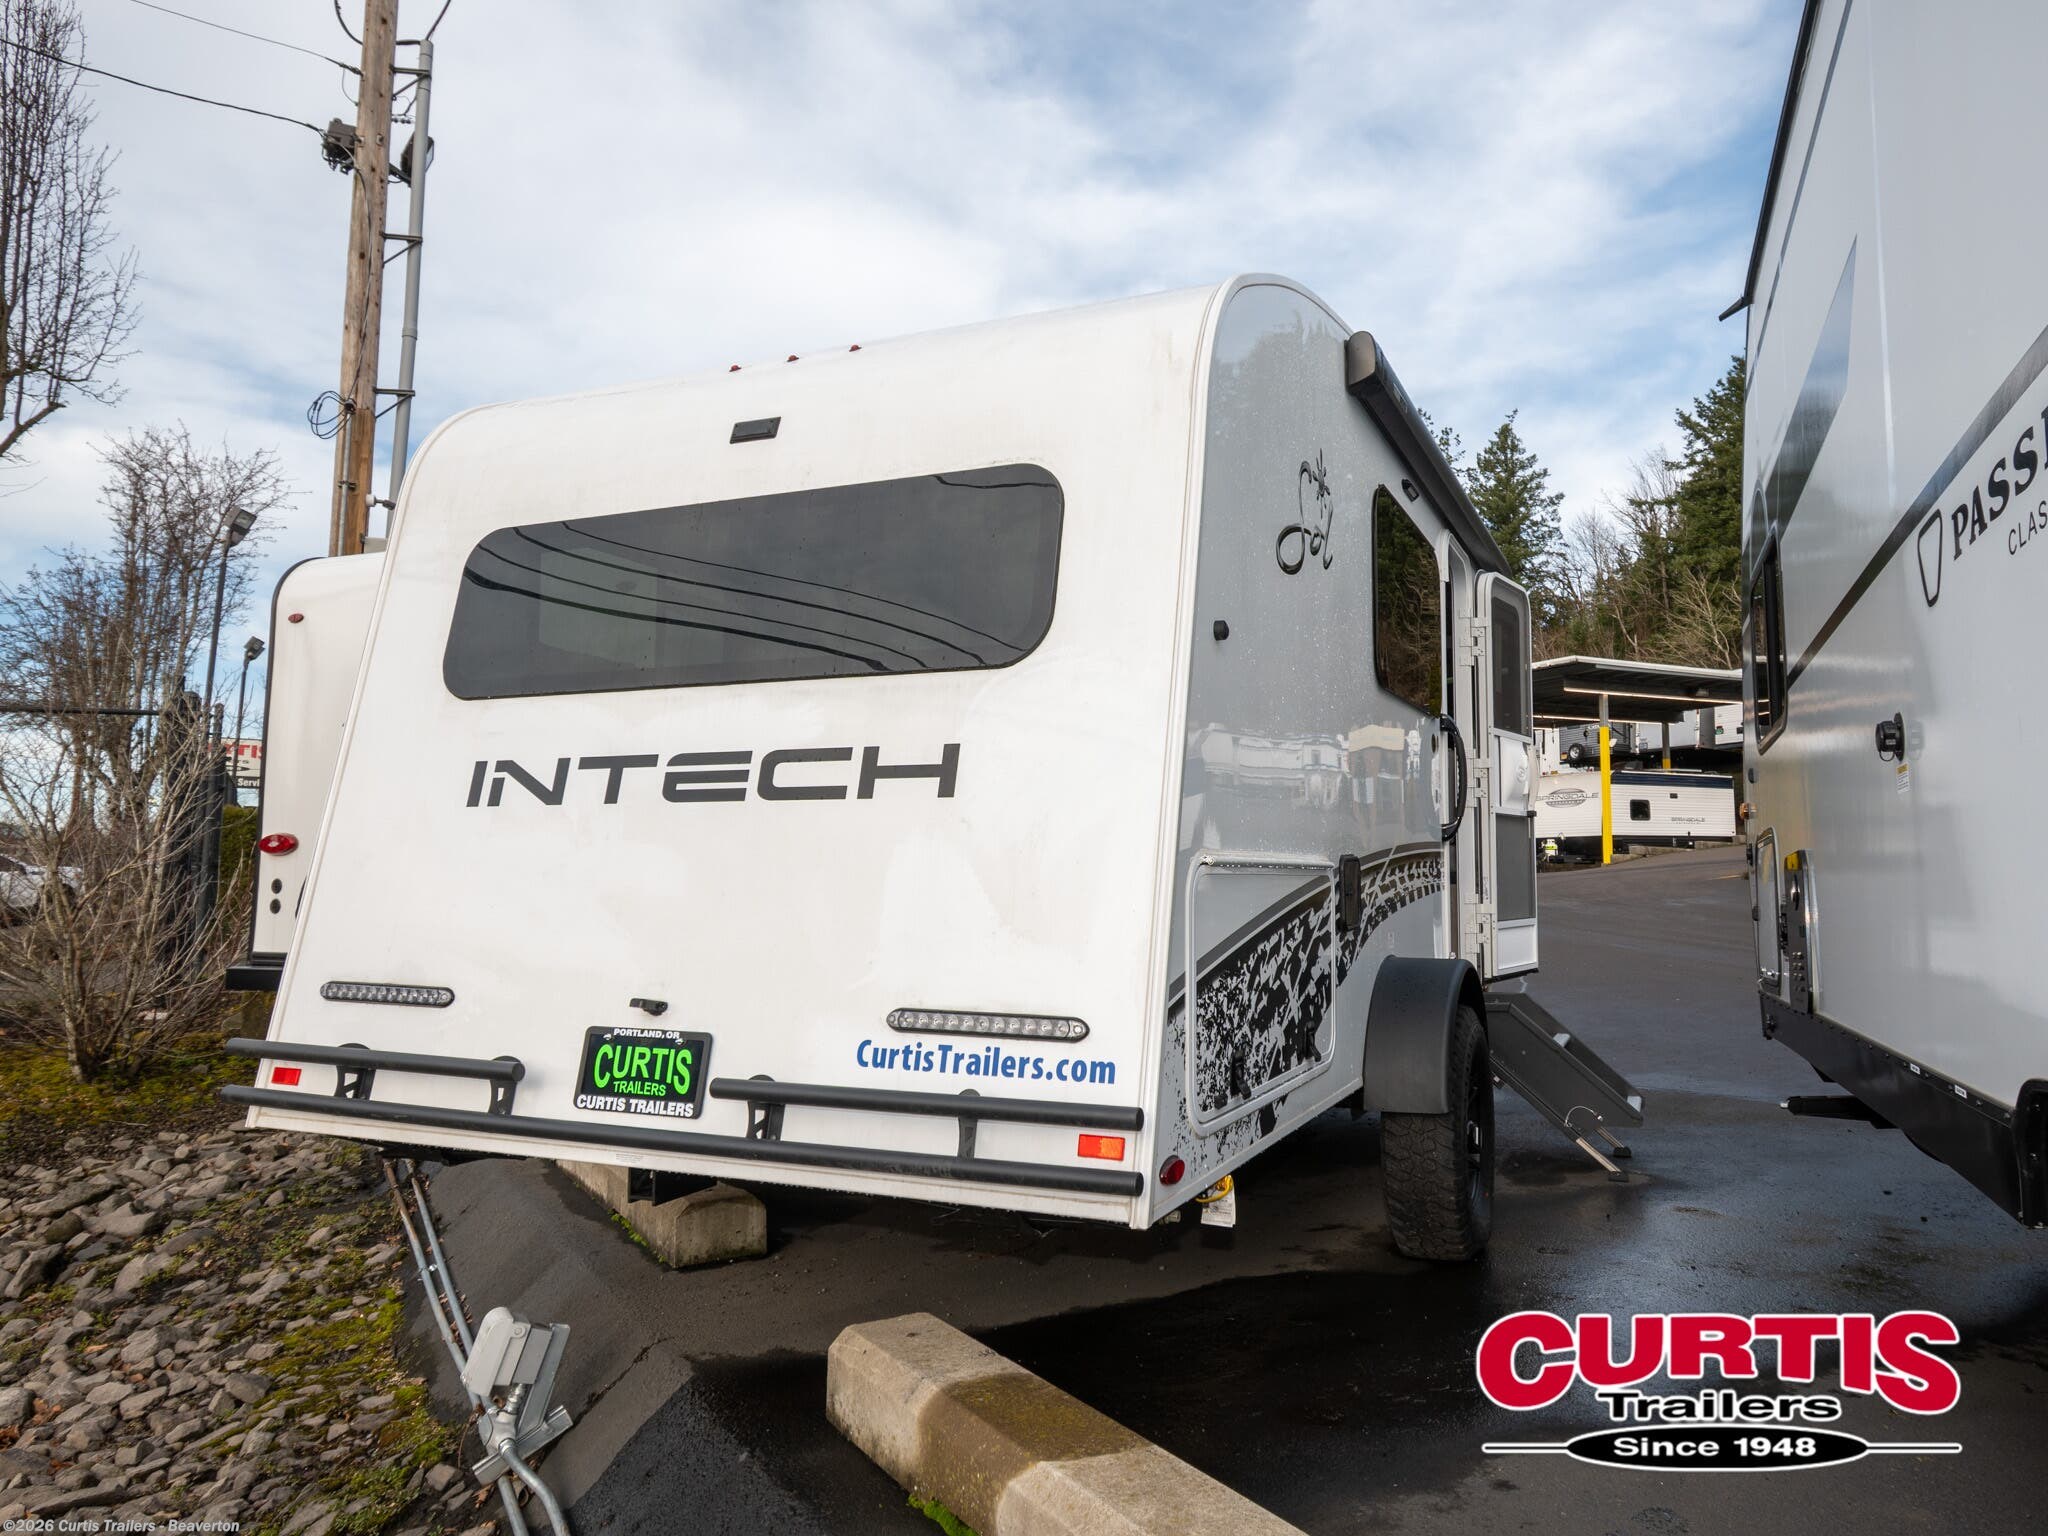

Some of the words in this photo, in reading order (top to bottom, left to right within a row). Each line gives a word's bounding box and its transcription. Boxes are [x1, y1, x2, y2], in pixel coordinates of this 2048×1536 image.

[1951, 405, 2048, 561] PASS
[237, 778, 260, 787] Servi
[466, 743, 961, 808] INTECH
[613, 1028, 665, 1039] PORTLAND,
[593, 1043, 693, 1095] CURTIS
[856, 1039, 1117, 1085] CurtisTrailers.com
[576, 1094, 627, 1112] CURTIS
[629, 1098, 694, 1118] TRAILERS
[613, 1080, 667, 1097] TRAILERS
